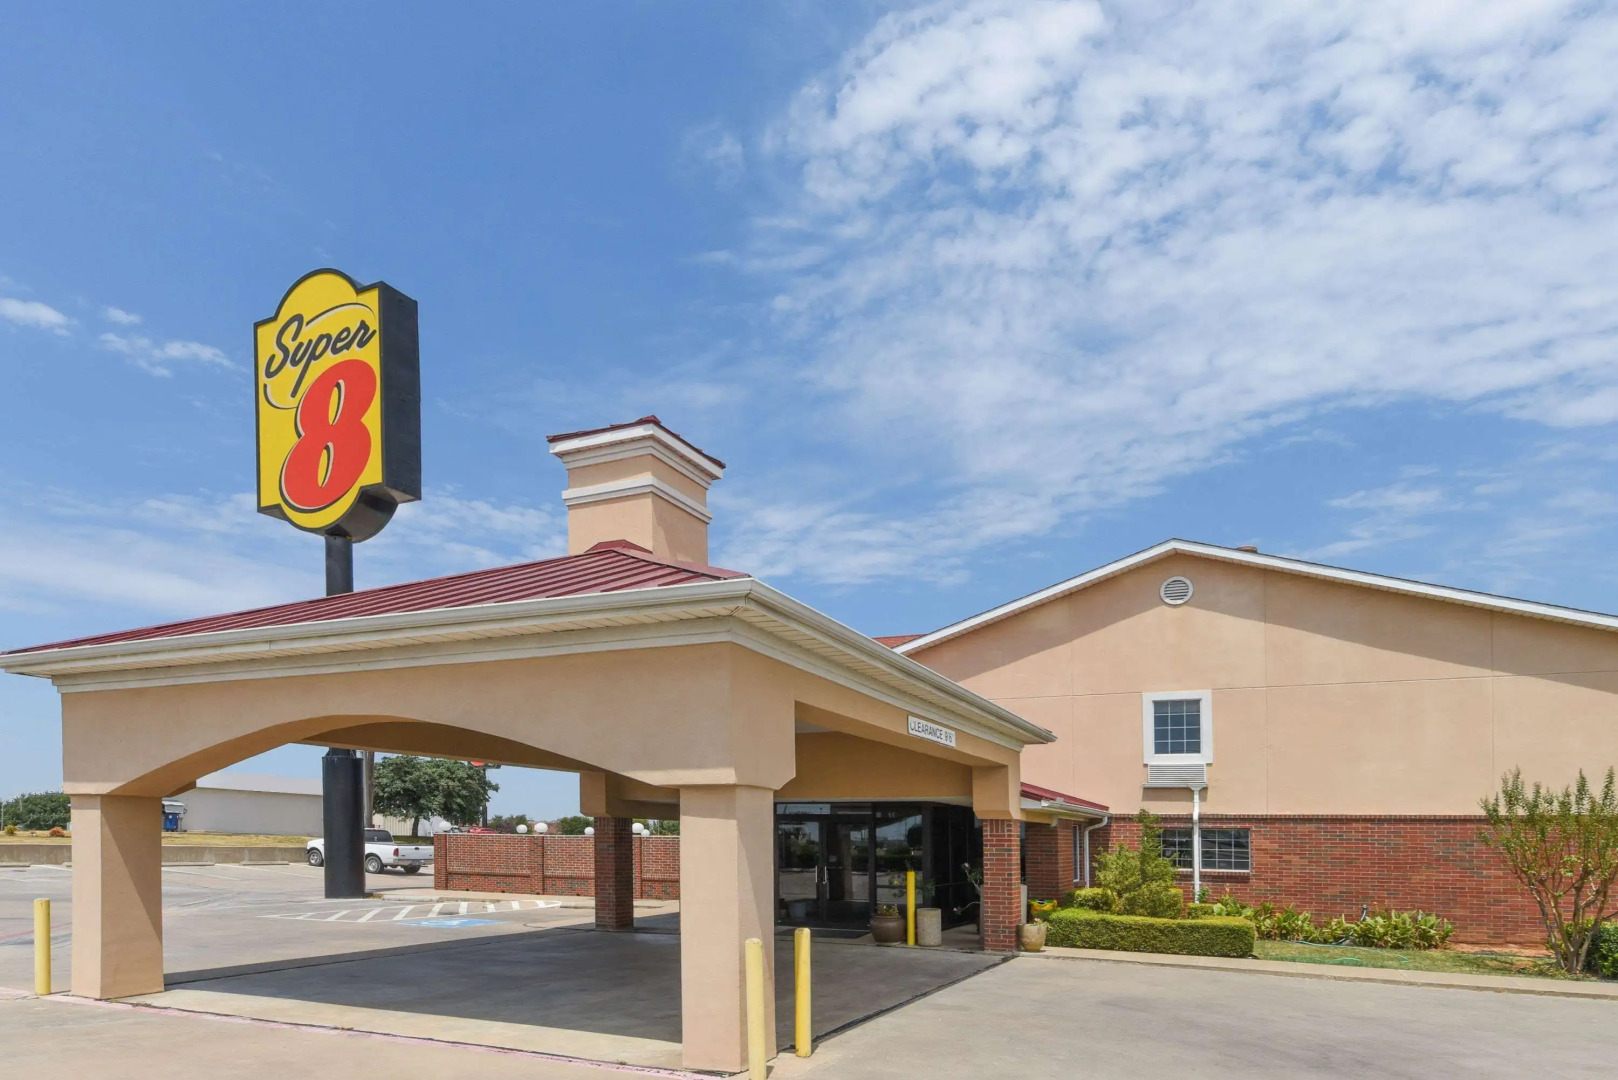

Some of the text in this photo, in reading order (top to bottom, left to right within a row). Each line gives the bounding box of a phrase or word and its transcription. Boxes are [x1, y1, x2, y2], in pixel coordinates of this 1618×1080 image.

[264, 313, 377, 399] Super
[279, 358, 377, 514] 8
[909, 720, 943, 740] CLEARANCE
